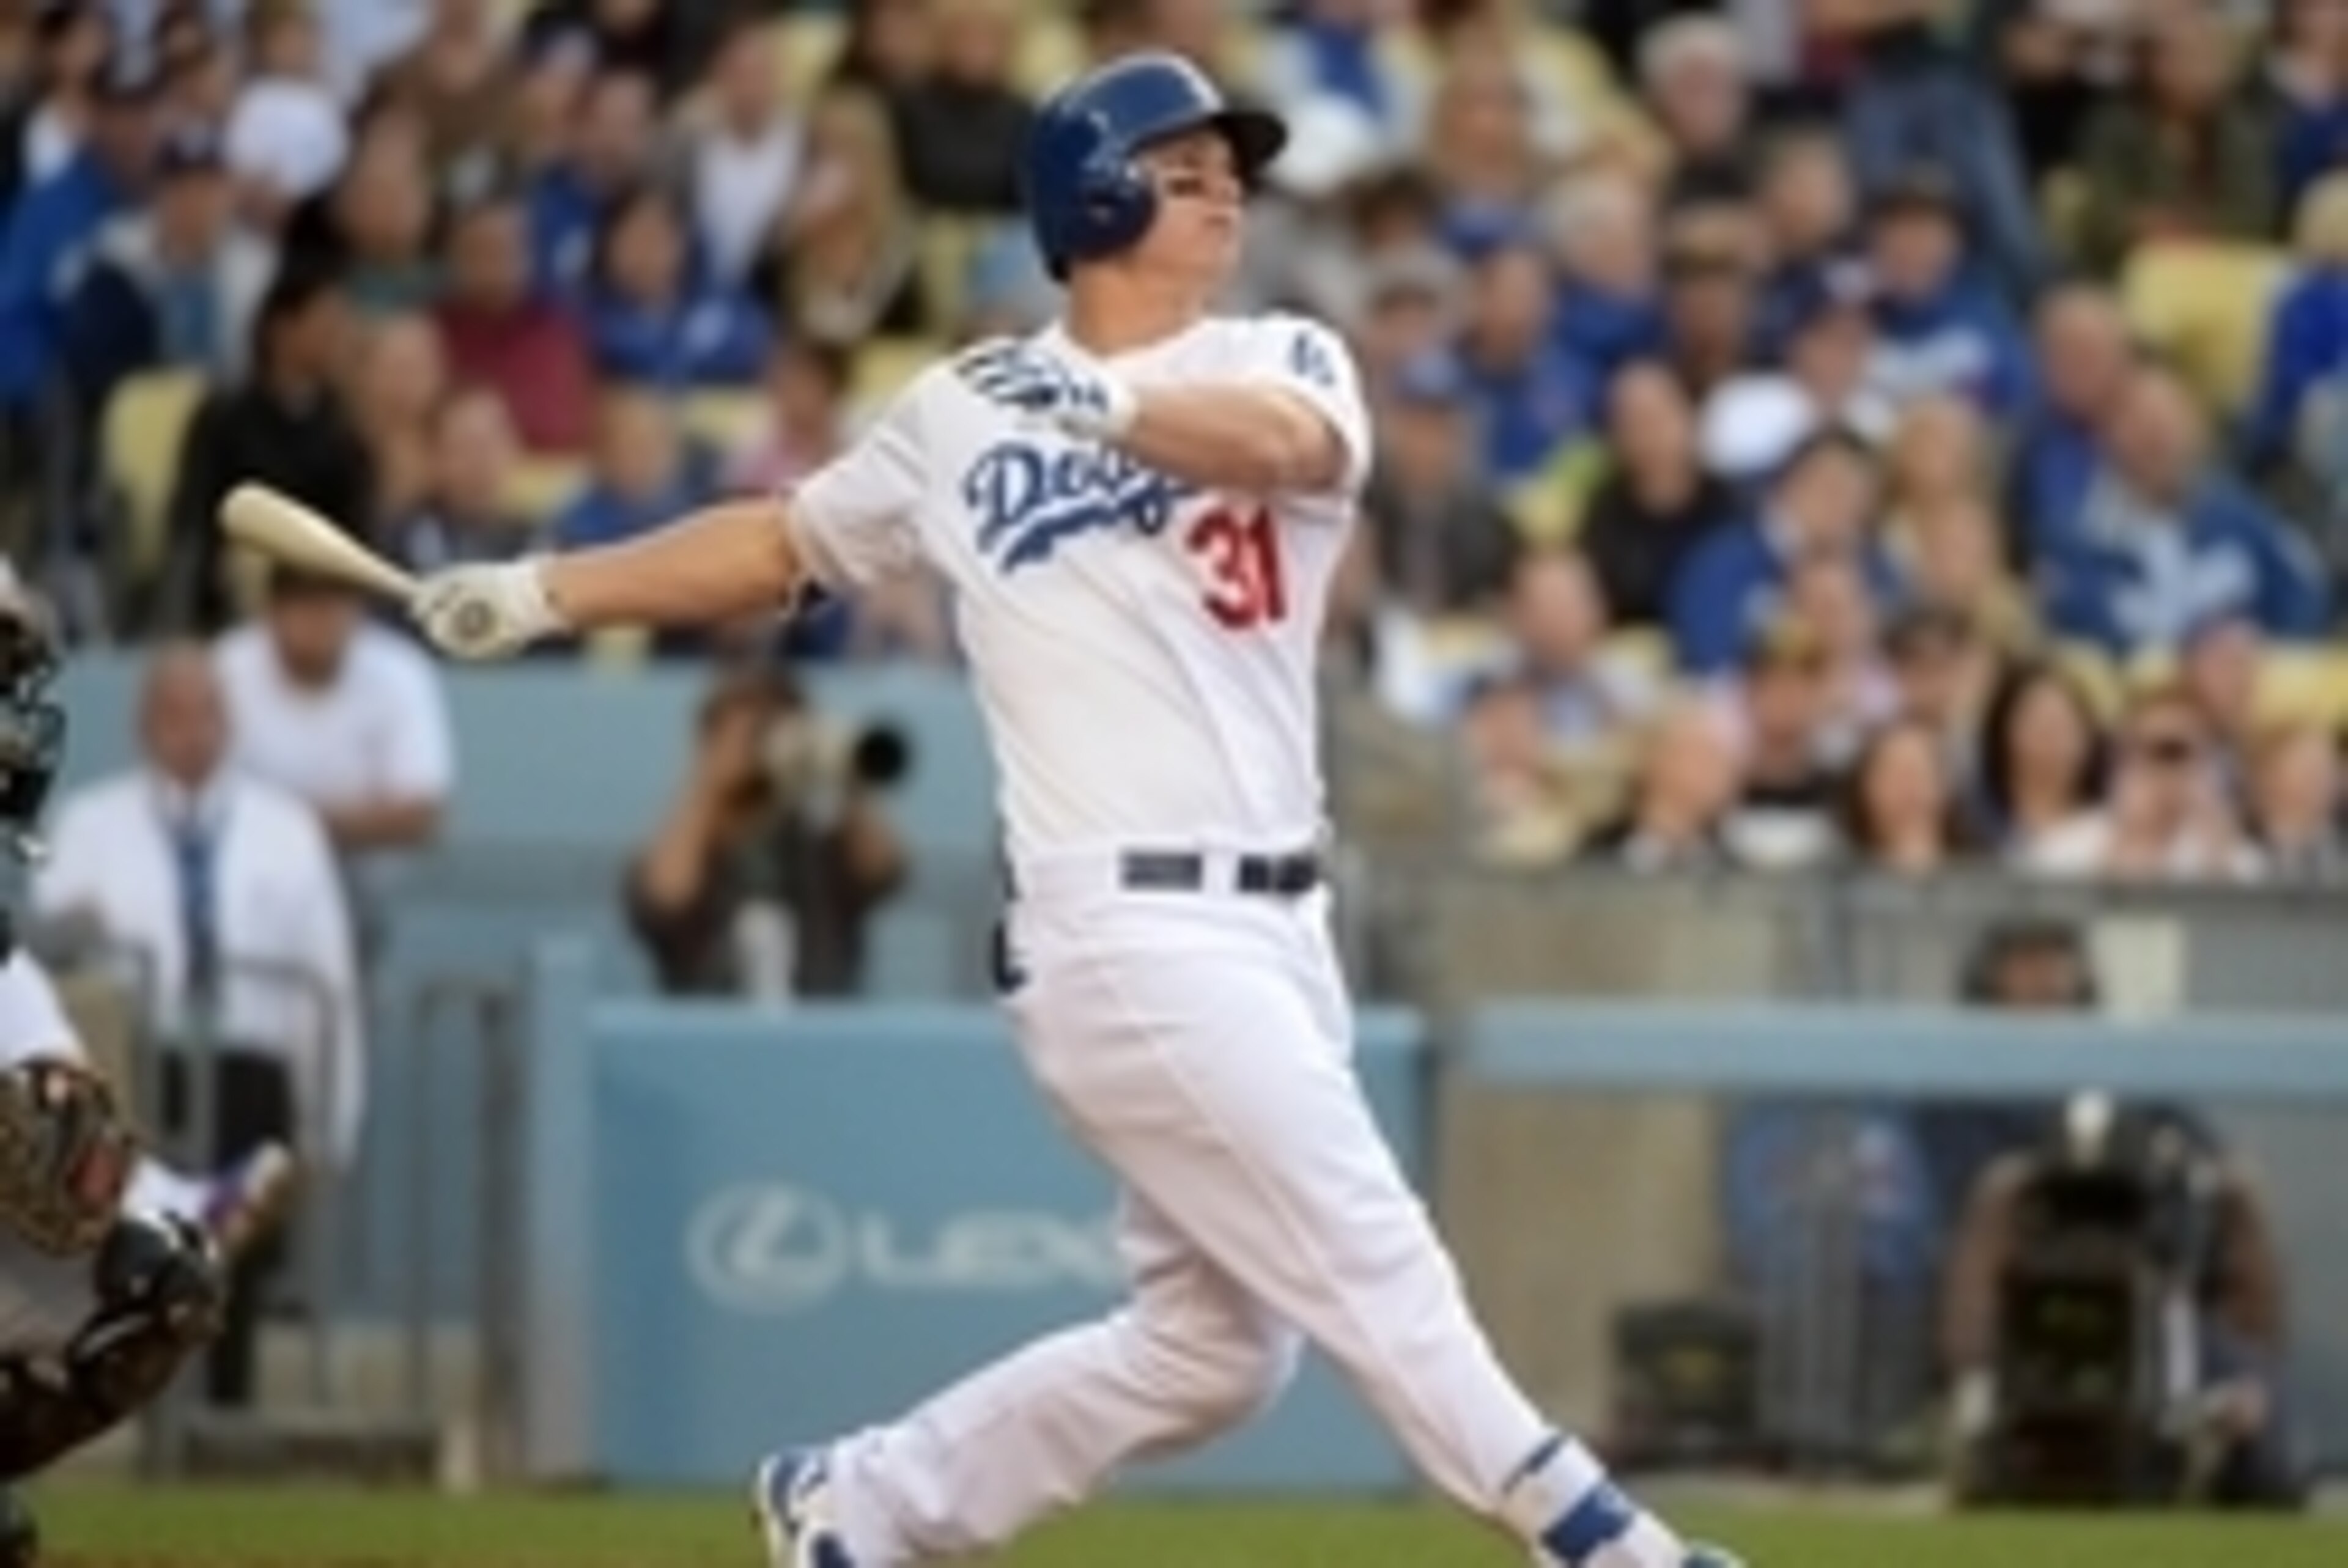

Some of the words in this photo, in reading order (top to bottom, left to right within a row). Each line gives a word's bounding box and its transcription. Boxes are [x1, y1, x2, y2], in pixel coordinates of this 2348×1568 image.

[964, 441, 1195, 569] Dodg
[1186, 501, 1287, 630] 31
[859, 1209, 1122, 1290] LEX
